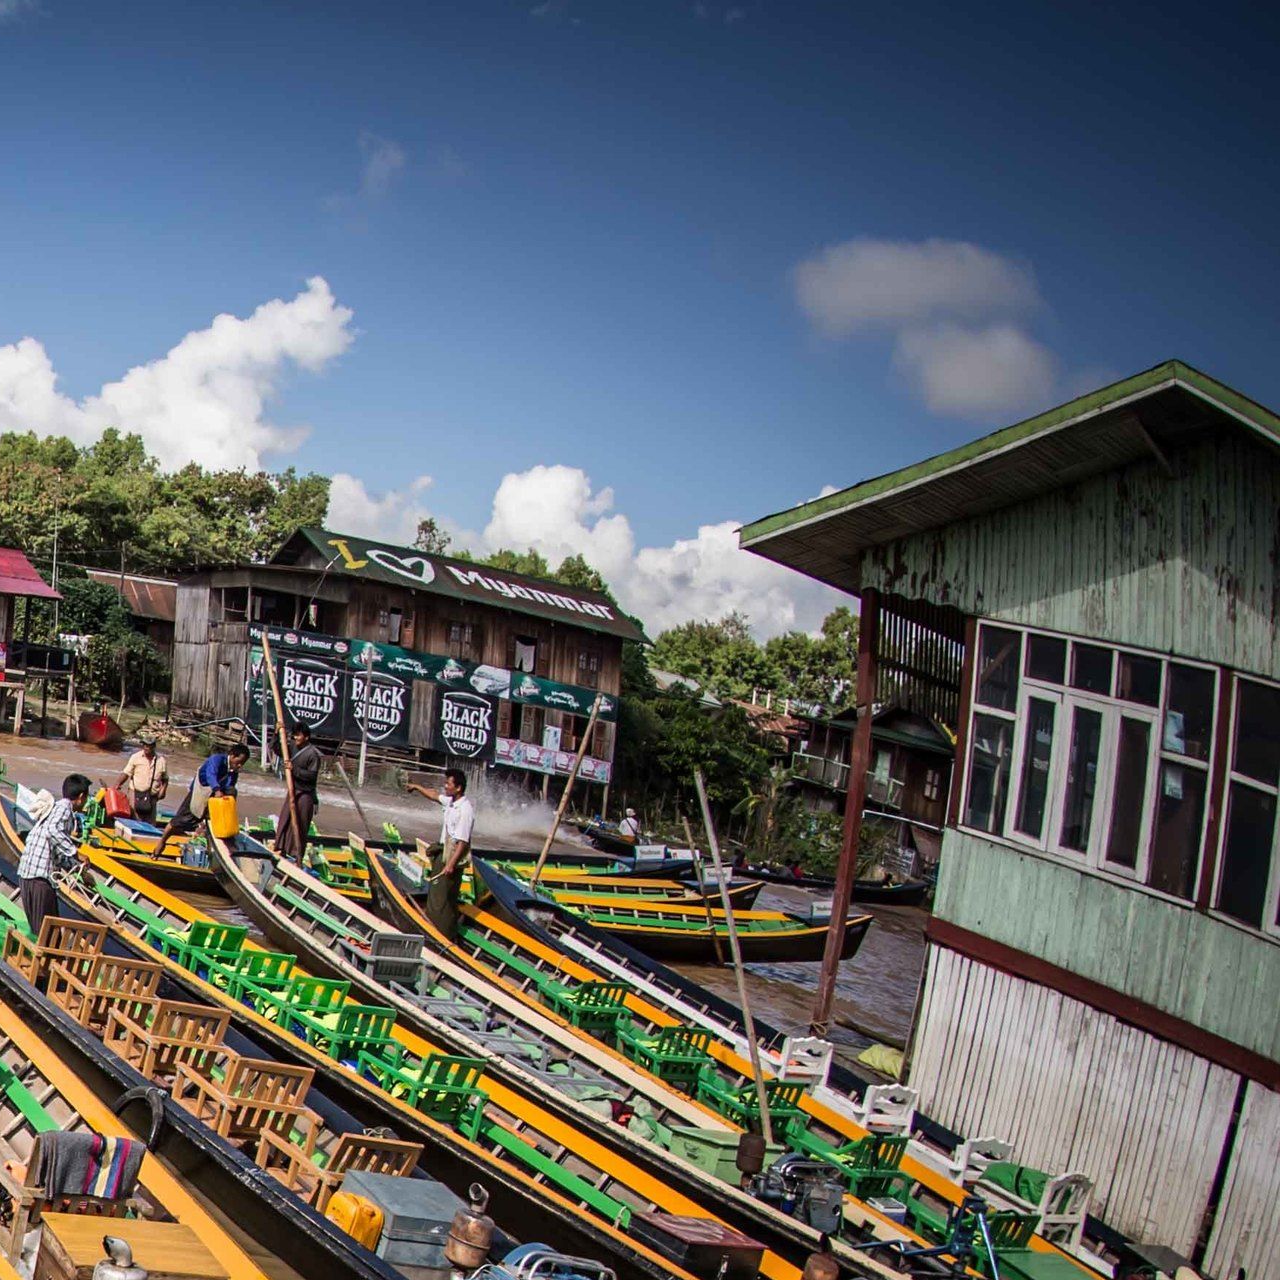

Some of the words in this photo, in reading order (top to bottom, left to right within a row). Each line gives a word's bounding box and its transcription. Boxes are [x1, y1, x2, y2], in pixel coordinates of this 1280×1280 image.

[445, 564, 614, 620] Myanmar
[282, 666, 339, 698] BLACK
[284, 690, 334, 714] SHIELD
[296, 709, 321, 720] STOUT
[441, 699, 492, 731] BLACK
[442, 723, 488, 746] SHIELD
[452, 741, 475, 752] STOUT
